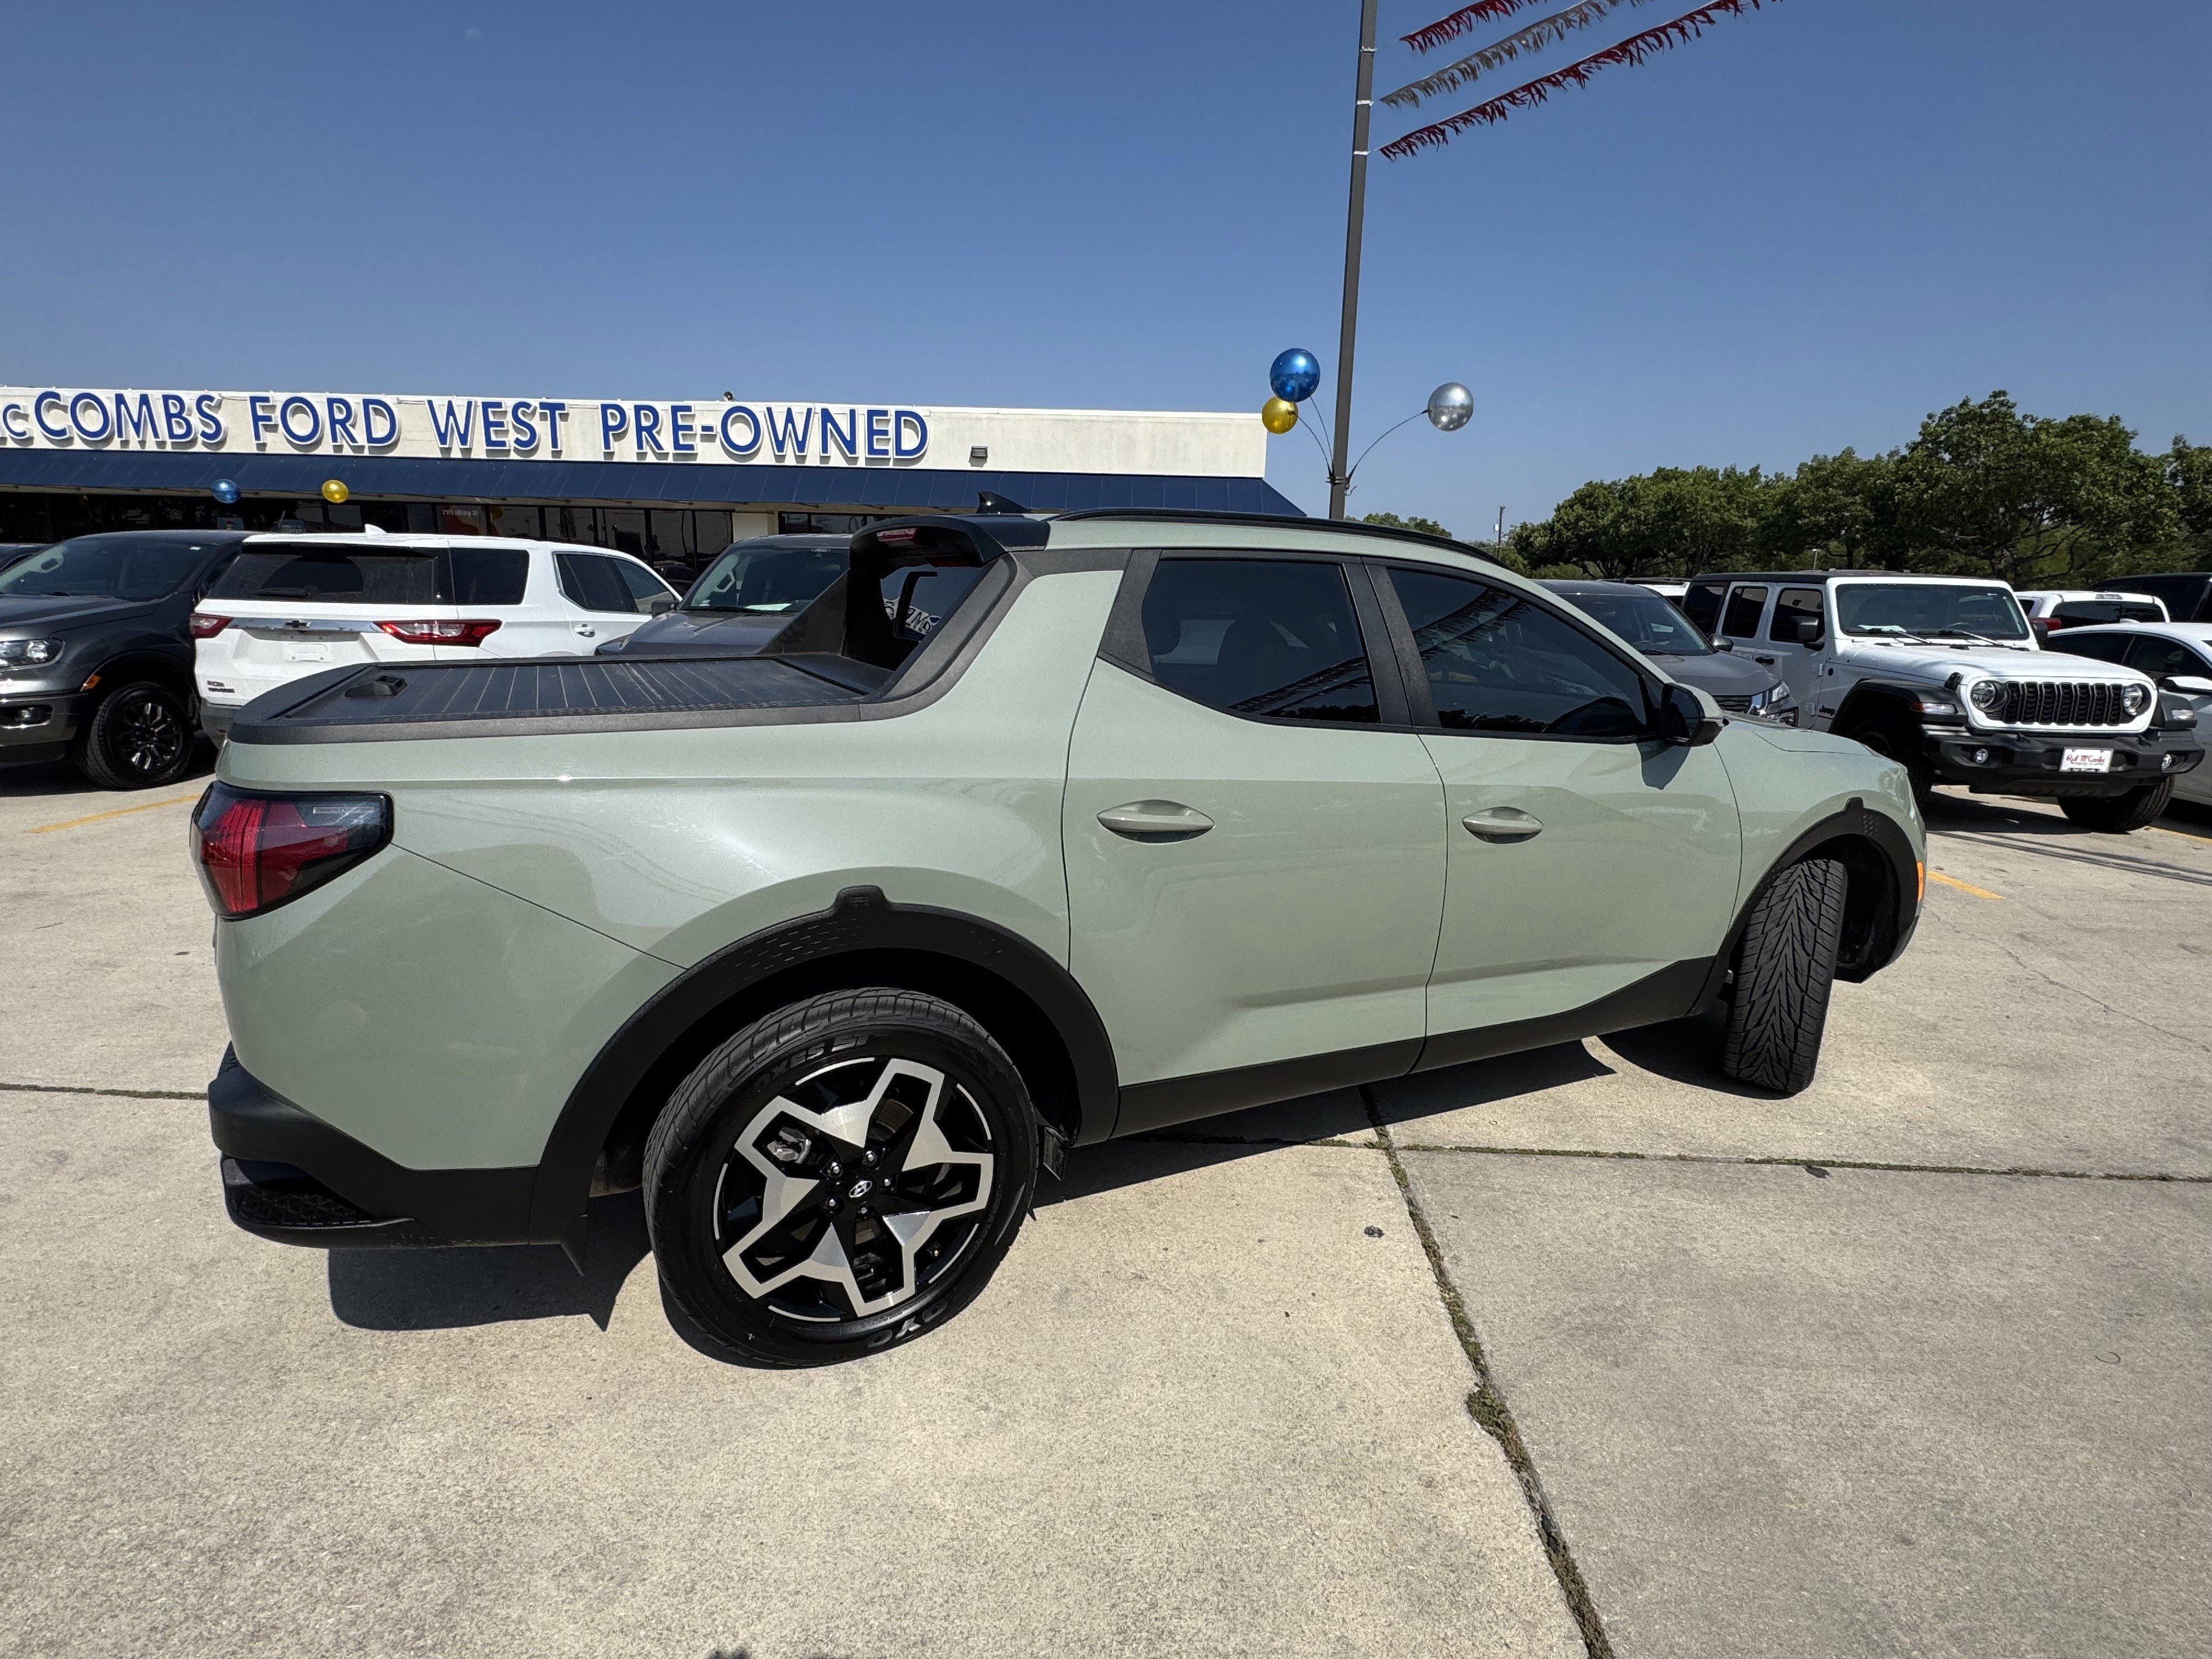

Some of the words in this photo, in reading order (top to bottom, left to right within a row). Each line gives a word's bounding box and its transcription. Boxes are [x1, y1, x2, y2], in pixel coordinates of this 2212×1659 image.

[249, 395, 397, 445] FORD
[426, 400, 567, 449] WEST
[600, 403, 928, 458] PRE-OWNED
